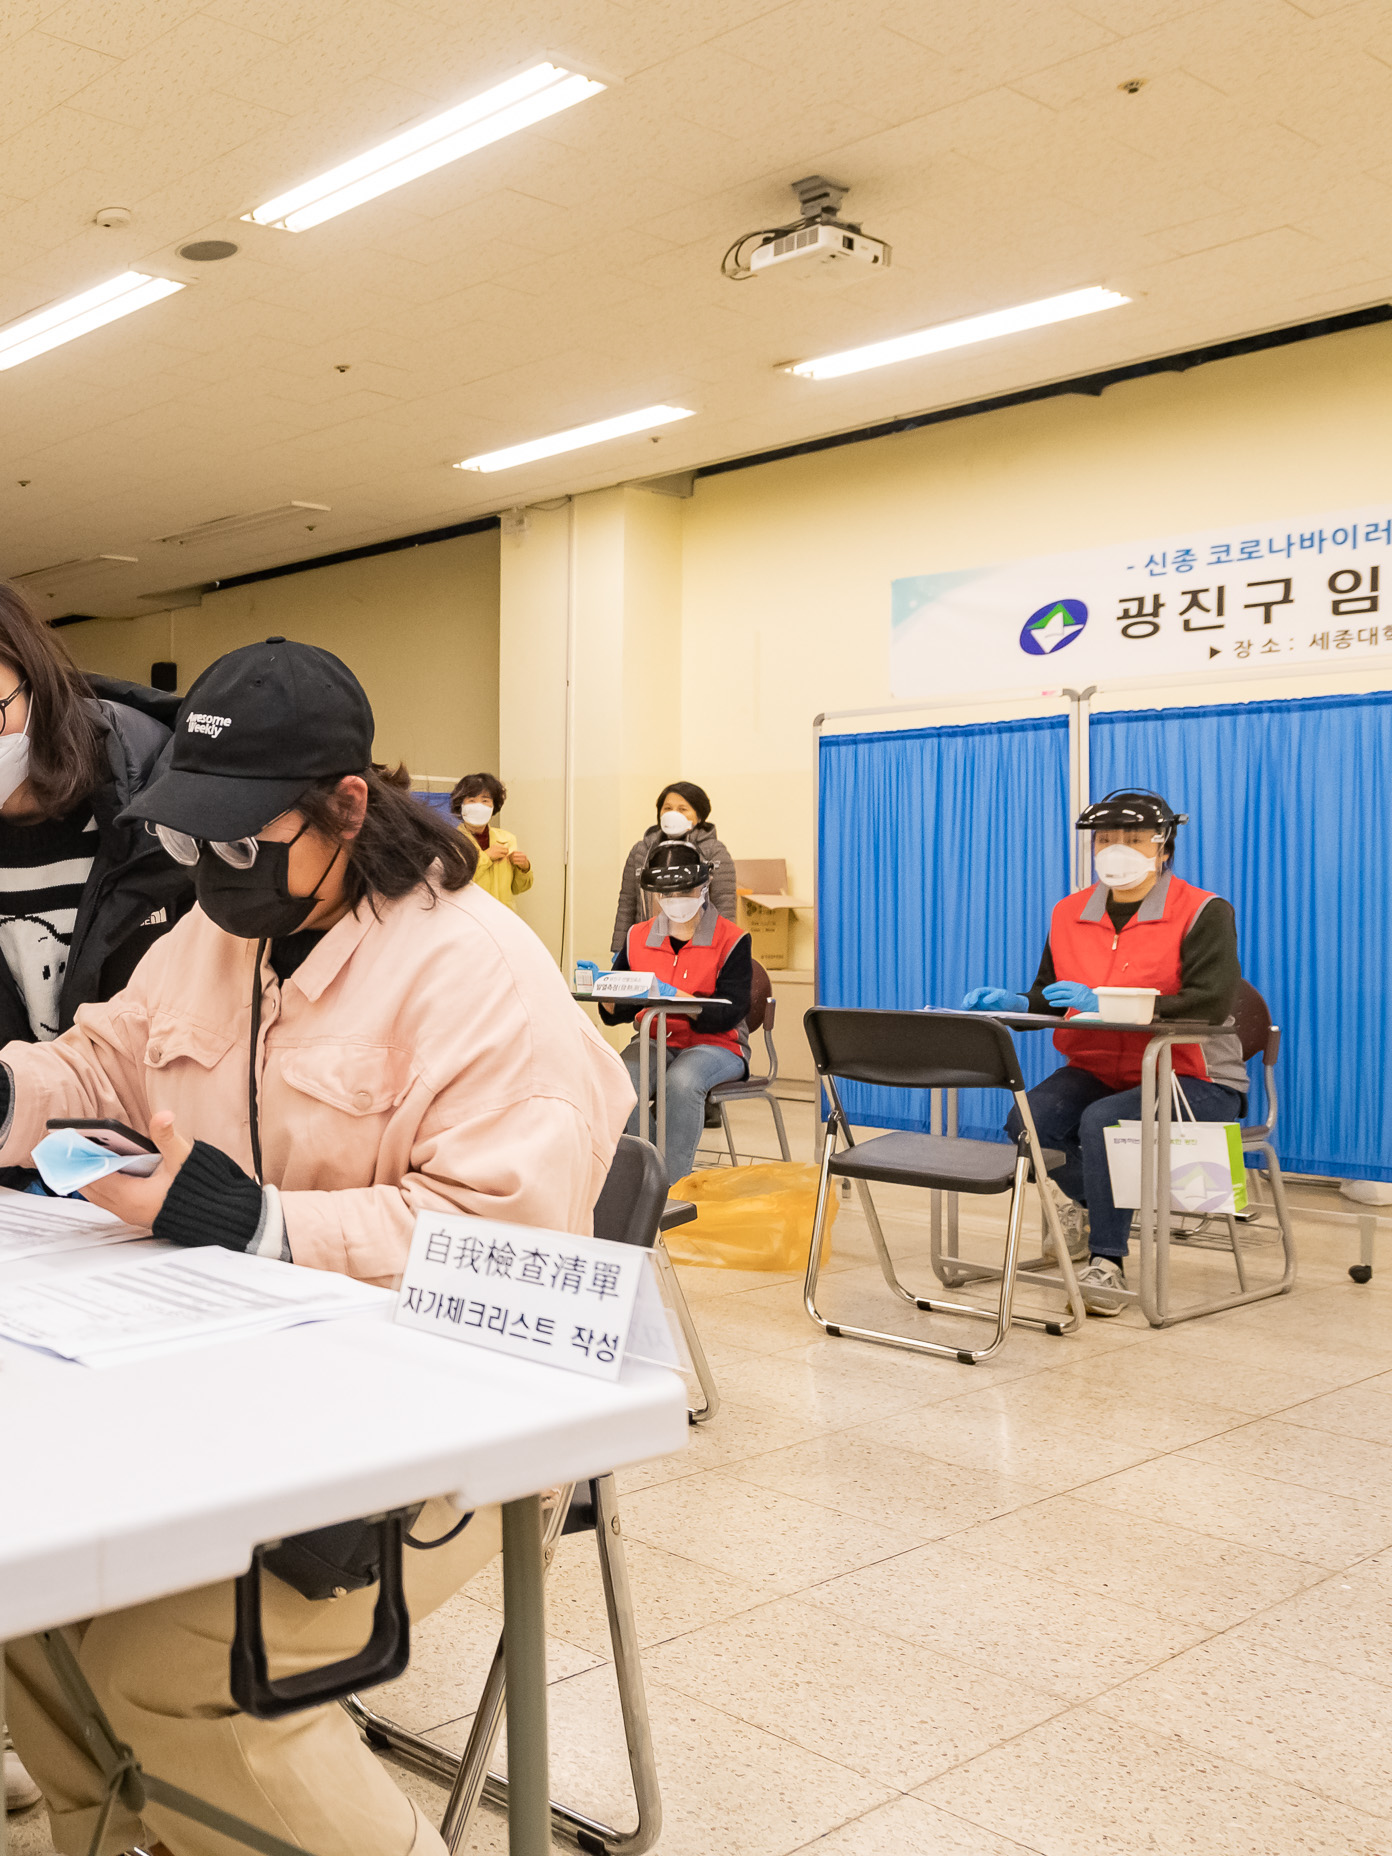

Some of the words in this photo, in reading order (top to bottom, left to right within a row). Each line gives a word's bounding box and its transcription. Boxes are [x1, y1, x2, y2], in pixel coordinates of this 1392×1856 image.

[1144, 548, 1198, 577] 신종
[1206, 519, 1392, 567] 코로나바이러
[1115, 577, 1295, 639] 광진구
[1327, 565, 1381, 616] 임
[186, 711, 233, 727] Awesome
[187, 720, 223, 739] Weekly
[424, 1228, 622, 1301] 自我檢查清單
[402, 1285, 556, 1346] 자가체크리스트
[570, 1326, 620, 1363] 작성
